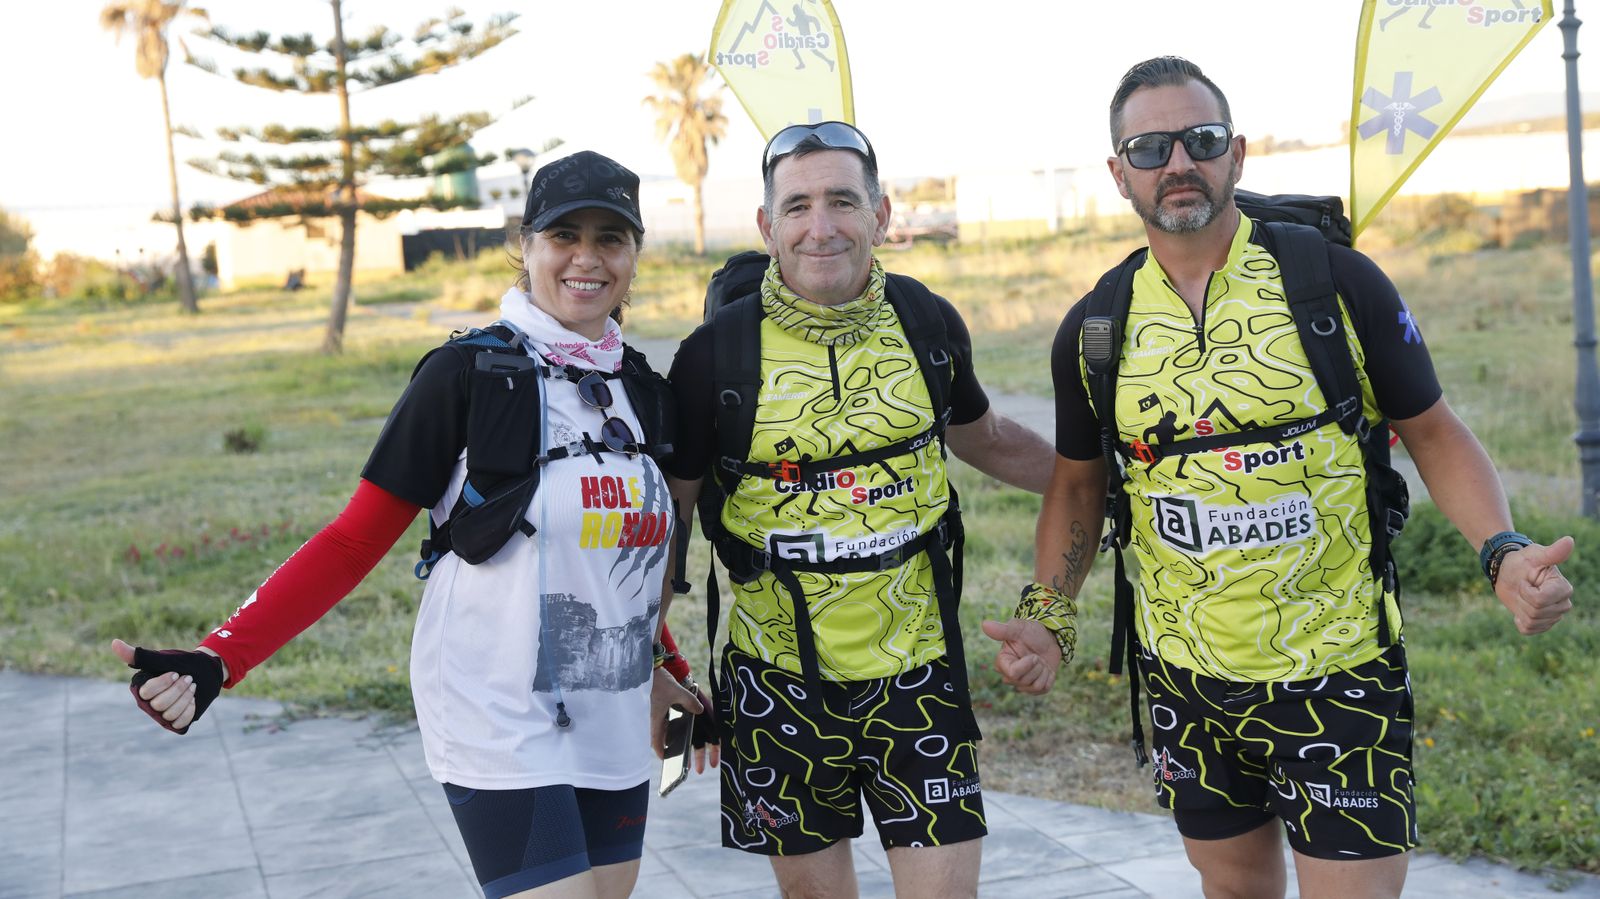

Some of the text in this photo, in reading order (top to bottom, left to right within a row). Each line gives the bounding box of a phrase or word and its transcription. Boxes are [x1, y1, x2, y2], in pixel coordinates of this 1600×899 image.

[1467, 6, 1541, 27] Sport
[1194, 419, 1215, 437] S
[1224, 441, 1304, 473] Sport
[580, 476, 643, 509] HOLE
[851, 476, 913, 505] Sport
[1209, 500, 1307, 522] Fundación
[579, 511, 667, 549] RONDA
[1208, 513, 1311, 545] ABADES
[835, 530, 919, 553] Fundación
[1164, 768, 1196, 781] Sport
[1332, 797, 1379, 808] ABADES
[769, 812, 799, 828] Sport
